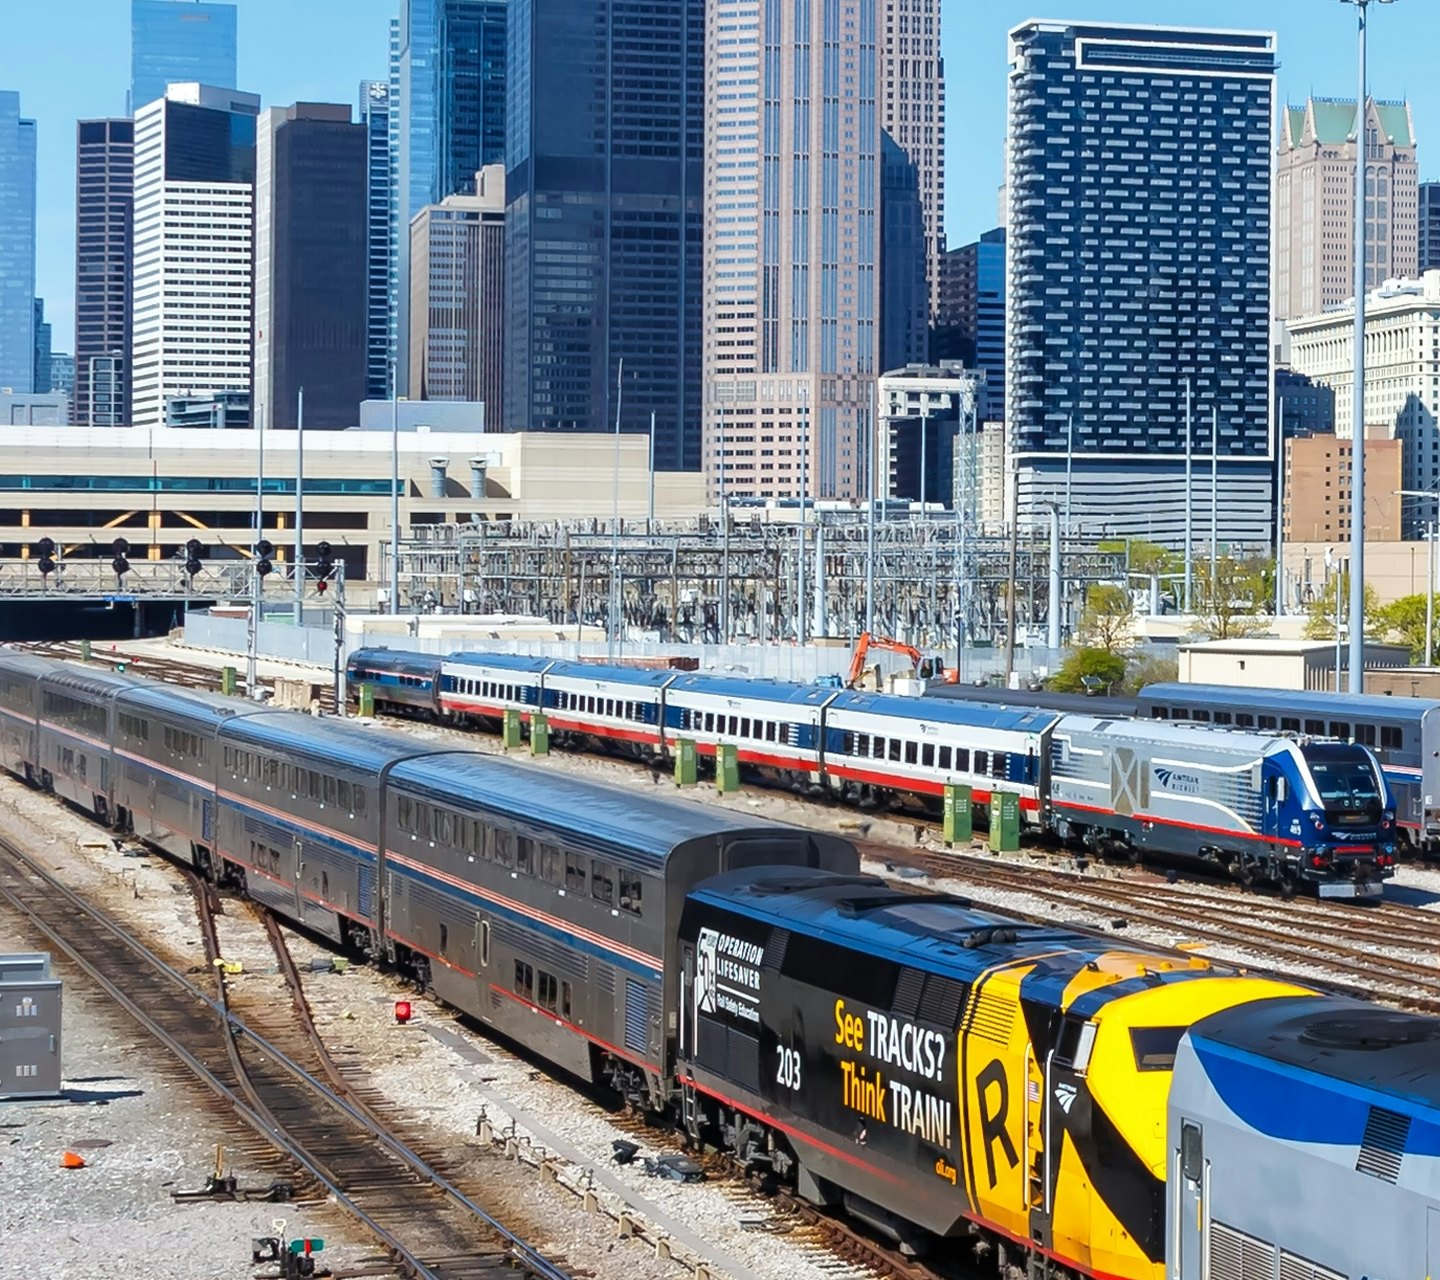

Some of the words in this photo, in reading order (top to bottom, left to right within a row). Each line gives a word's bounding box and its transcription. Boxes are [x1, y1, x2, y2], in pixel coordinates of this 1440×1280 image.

[716, 957, 761, 990] LIFESAVER
[717, 934, 764, 967] OPERATION
[835, 999, 864, 1052] See
[867, 1010, 946, 1082] TRACKS?
[776, 1045, 801, 1091] 203
[841, 1061, 886, 1122] Think
[890, 1080, 951, 1149] TRAIN!
[976, 1058, 1020, 1190] R
[935, 1158, 957, 1186] oli.org
